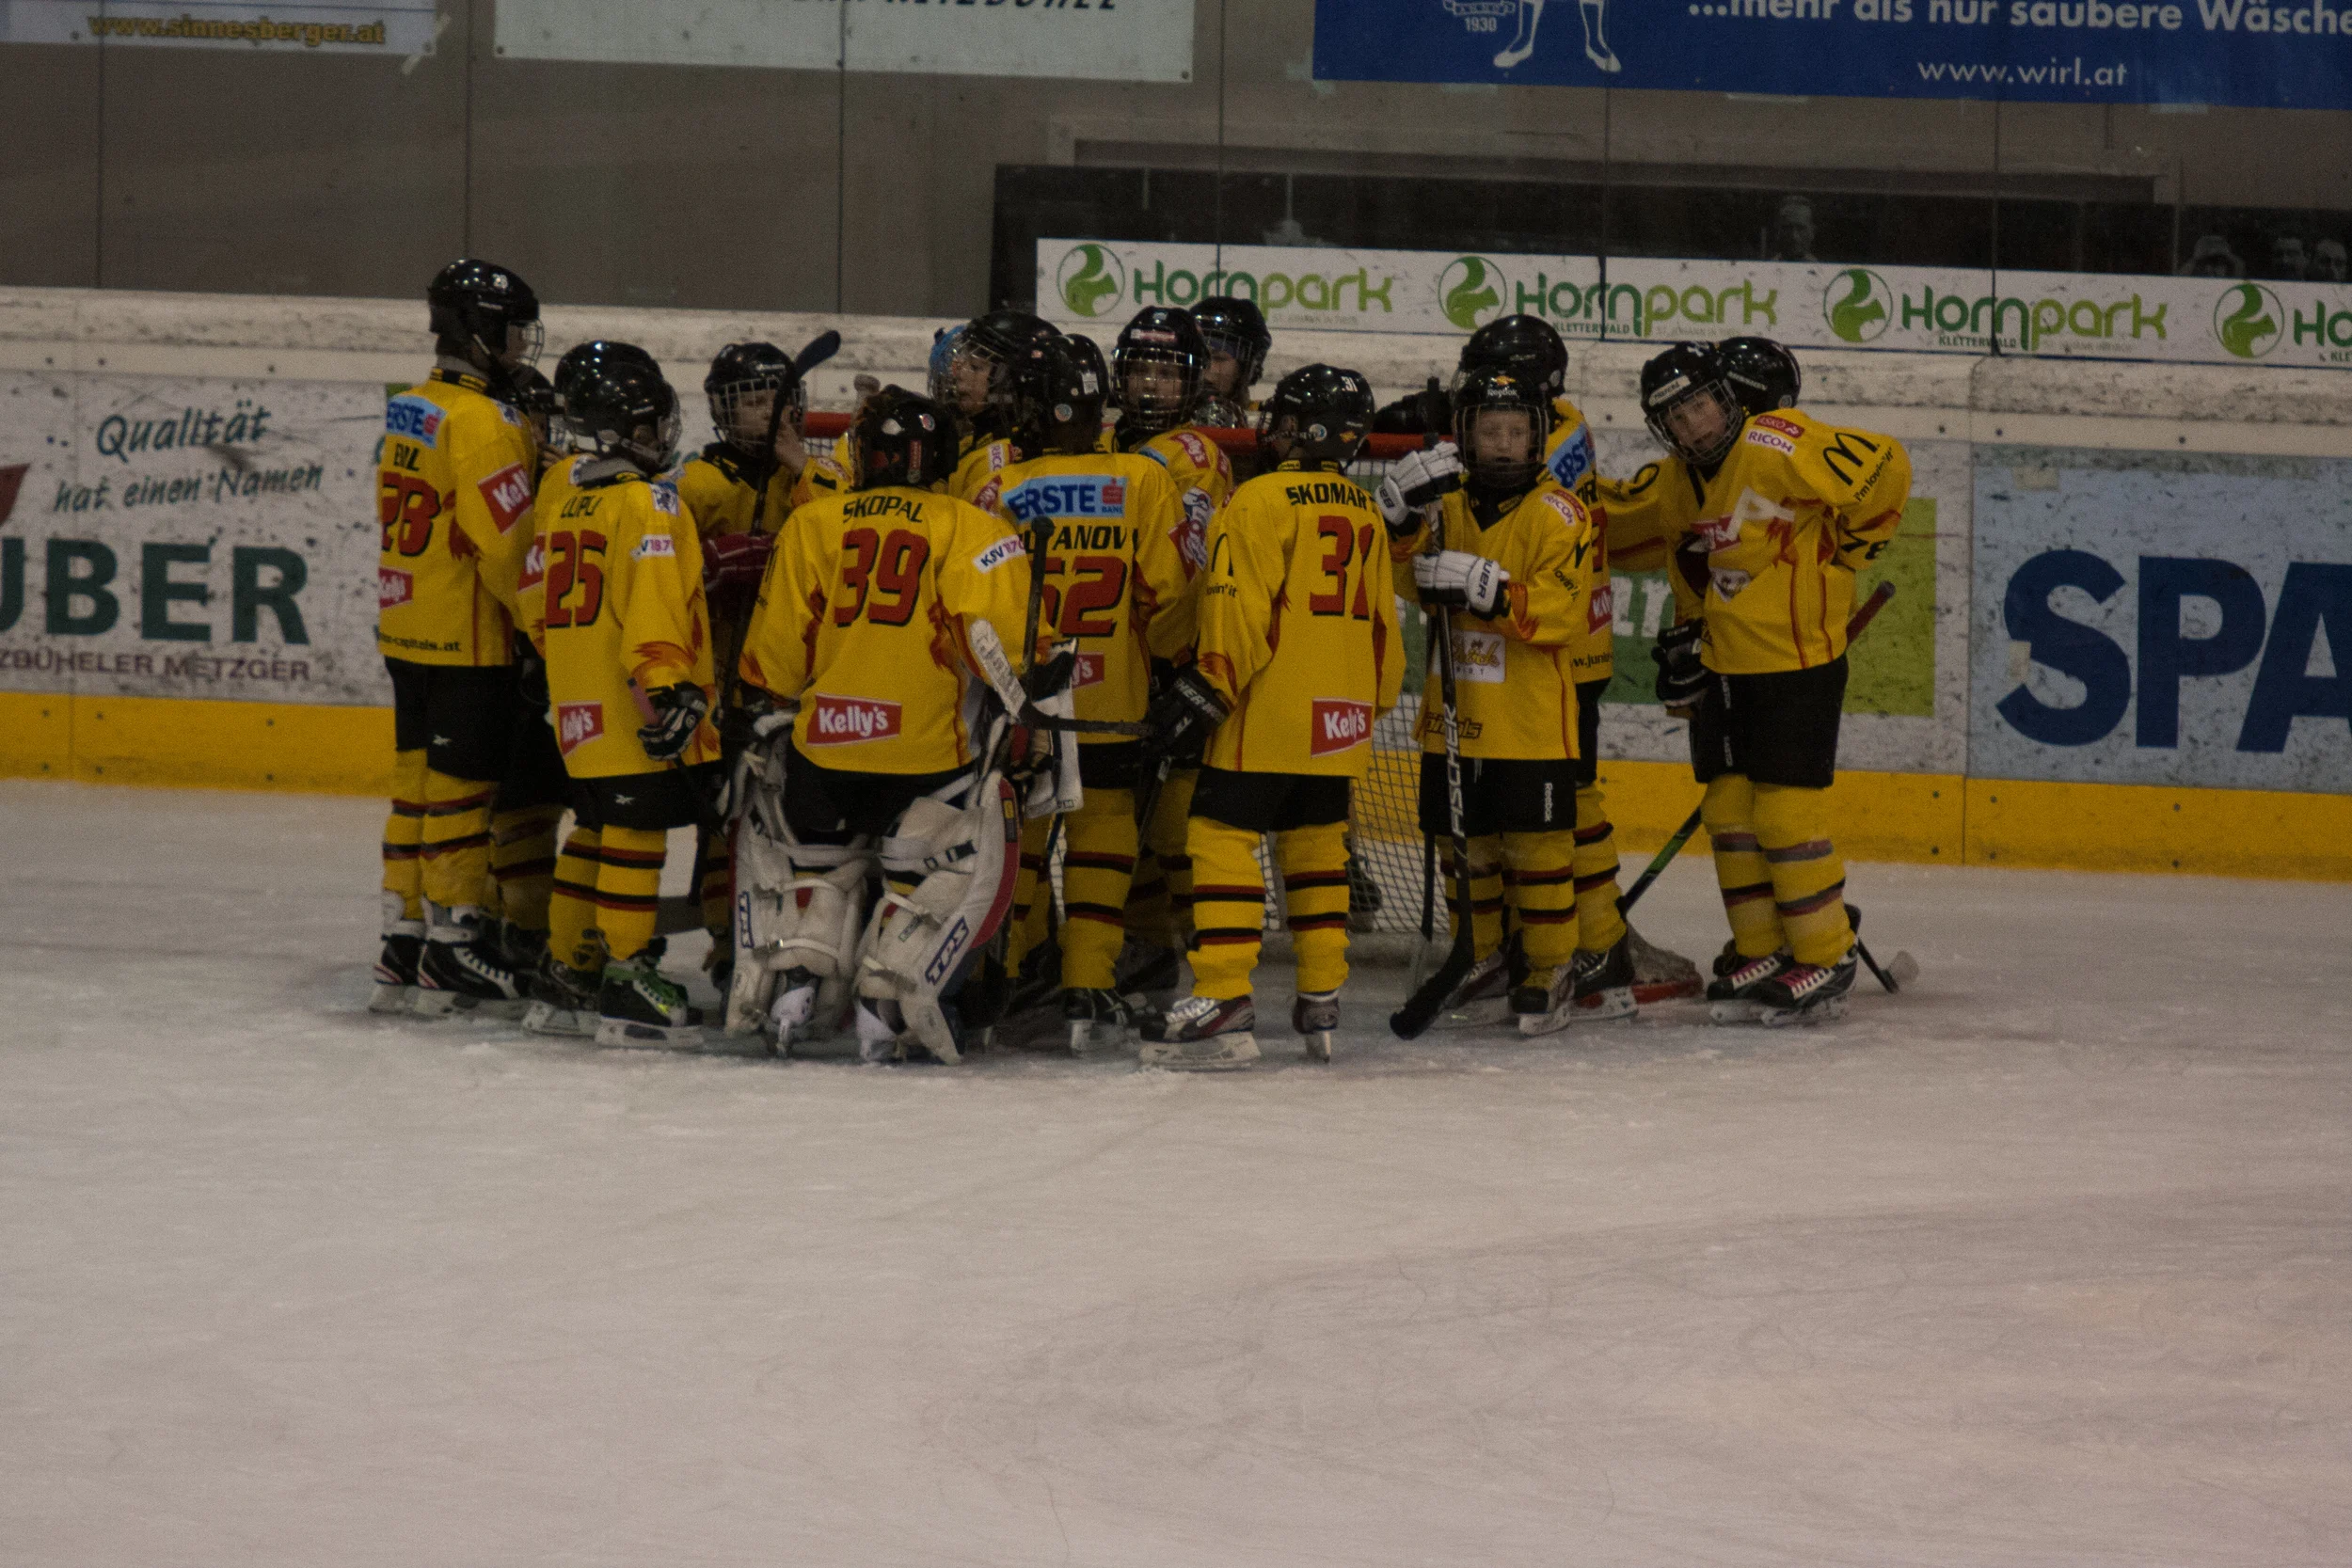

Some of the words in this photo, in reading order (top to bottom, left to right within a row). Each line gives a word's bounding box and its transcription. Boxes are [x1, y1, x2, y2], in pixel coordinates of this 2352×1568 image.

[87, 13, 386, 47] www.sinnesberger.at
[1465, 17, 1497, 31] 1930
[1853, 0, 1913, 22] als
[1929, 0, 1999, 24] nur
[2010, 0, 2183, 29] saubere
[1917, 57, 2128, 87] www.wirl.at
[1134, 260, 1394, 323] Hornpark
[1517, 272, 1778, 337] Hornpark
[1902, 285, 2167, 351] Hornpark
[97, 399, 271, 463] Qualität
[1748, 431, 1793, 452] RICOH
[54, 475, 112, 513] hat
[123, 478, 200, 509] einen
[214, 466, 324, 504] Namen
[843, 495, 923, 525] SKOPAL
[1008, 483, 1096, 520] ERSTE
[546, 530, 608, 629] 25
[834, 527, 930, 627] 39
[1310, 515, 1375, 621] 31
[163, 654, 310, 682] METZGER
[1995, 549, 2352, 753] SPA
[818, 705, 889, 737] Kelly's
